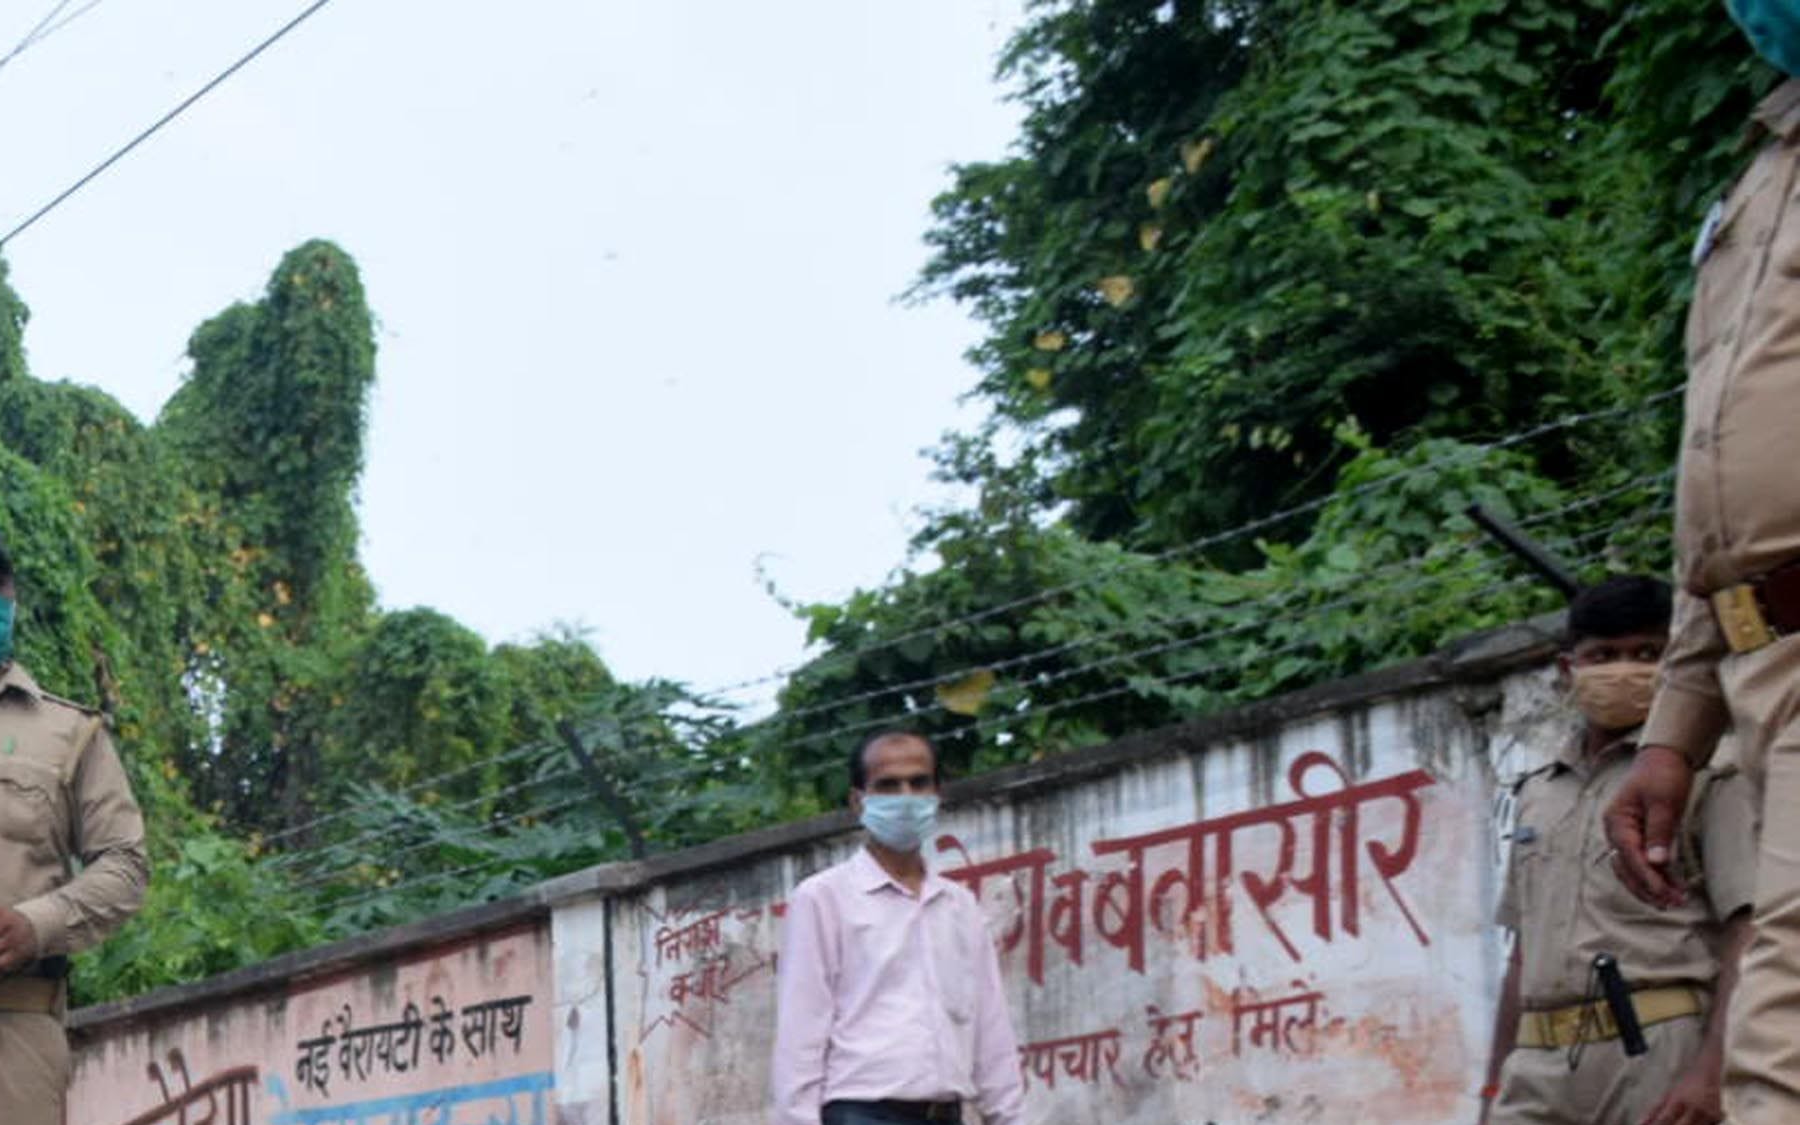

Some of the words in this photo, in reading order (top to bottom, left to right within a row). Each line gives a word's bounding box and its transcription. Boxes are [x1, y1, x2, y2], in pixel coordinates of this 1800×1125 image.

[296, 1018, 336, 1096] नई
[430, 996, 456, 1060] के
[460, 995, 533, 1058] साथ
